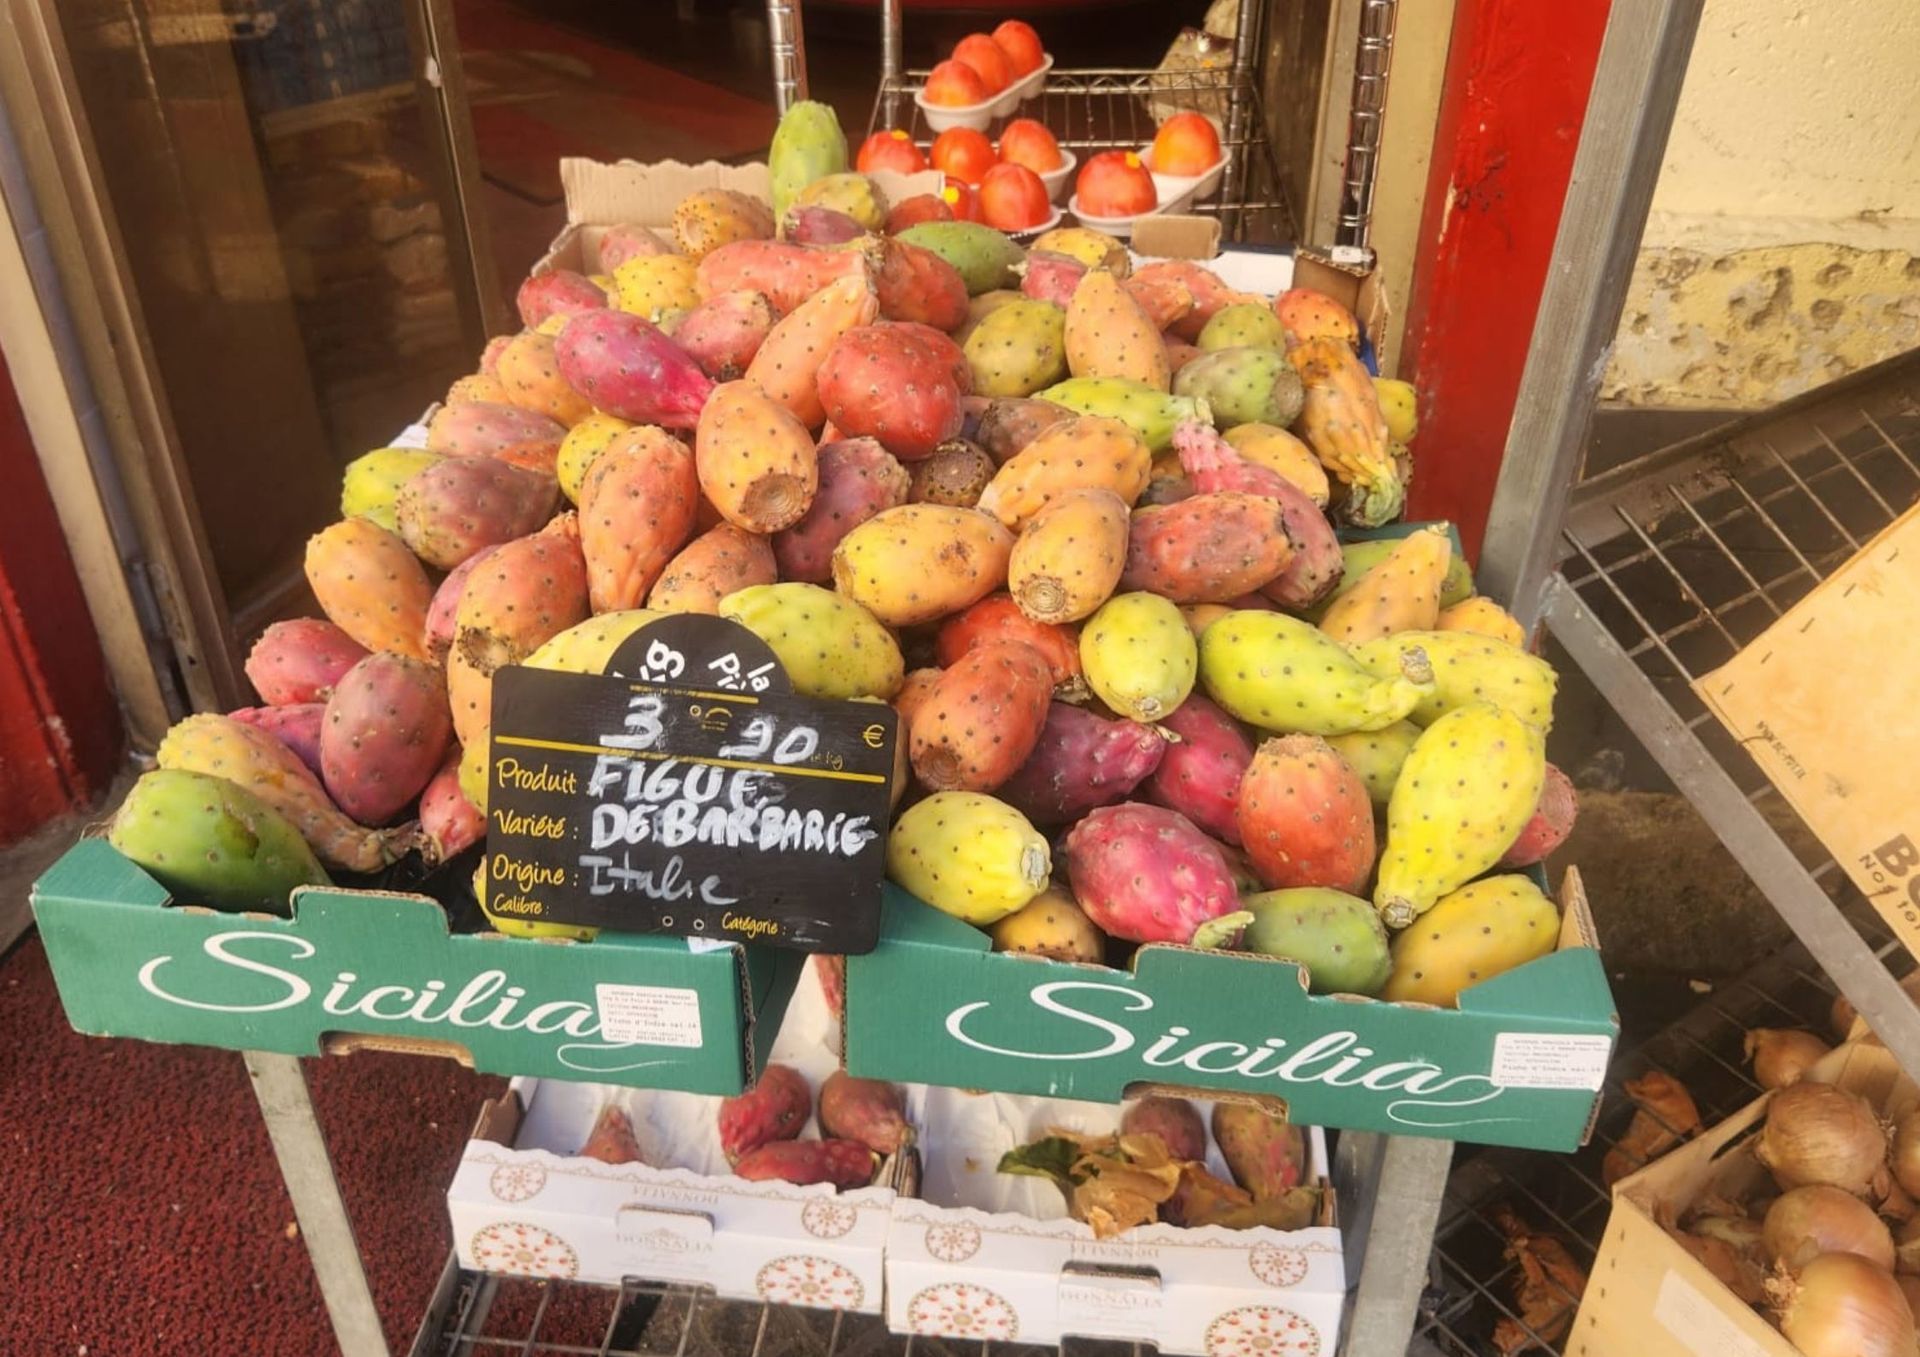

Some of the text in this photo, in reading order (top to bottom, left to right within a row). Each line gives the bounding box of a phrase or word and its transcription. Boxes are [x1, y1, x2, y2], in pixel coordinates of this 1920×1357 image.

[600, 696, 664, 750] 3
[863, 724, 886, 749] €
[495, 754, 774, 809] Produit FIGUE
[494, 809, 566, 840] Variété
[492, 854, 566, 893] Origine
[579, 851, 738, 906] Italie
[137, 930, 605, 1042] Sicilia
[945, 980, 1445, 1097] Sicilia
